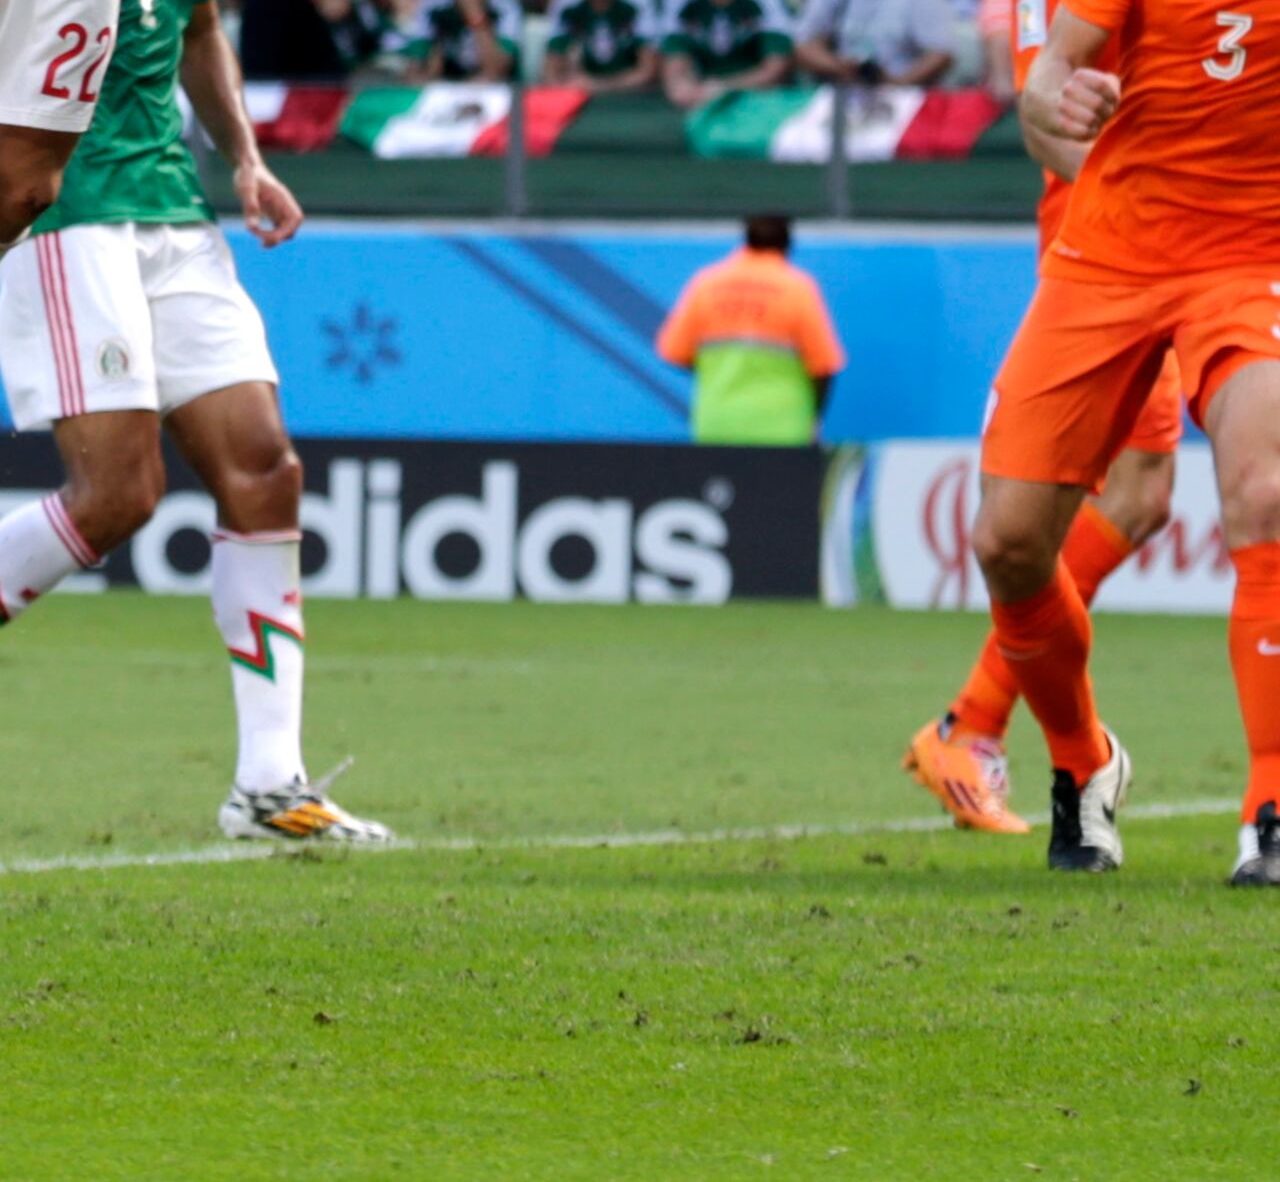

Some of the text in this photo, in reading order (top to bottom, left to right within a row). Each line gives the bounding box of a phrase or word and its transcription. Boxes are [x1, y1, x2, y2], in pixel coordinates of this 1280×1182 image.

[41, 22, 111, 103] 22
[1201, 10, 1253, 82] 3
[131, 458, 733, 604] adidas
